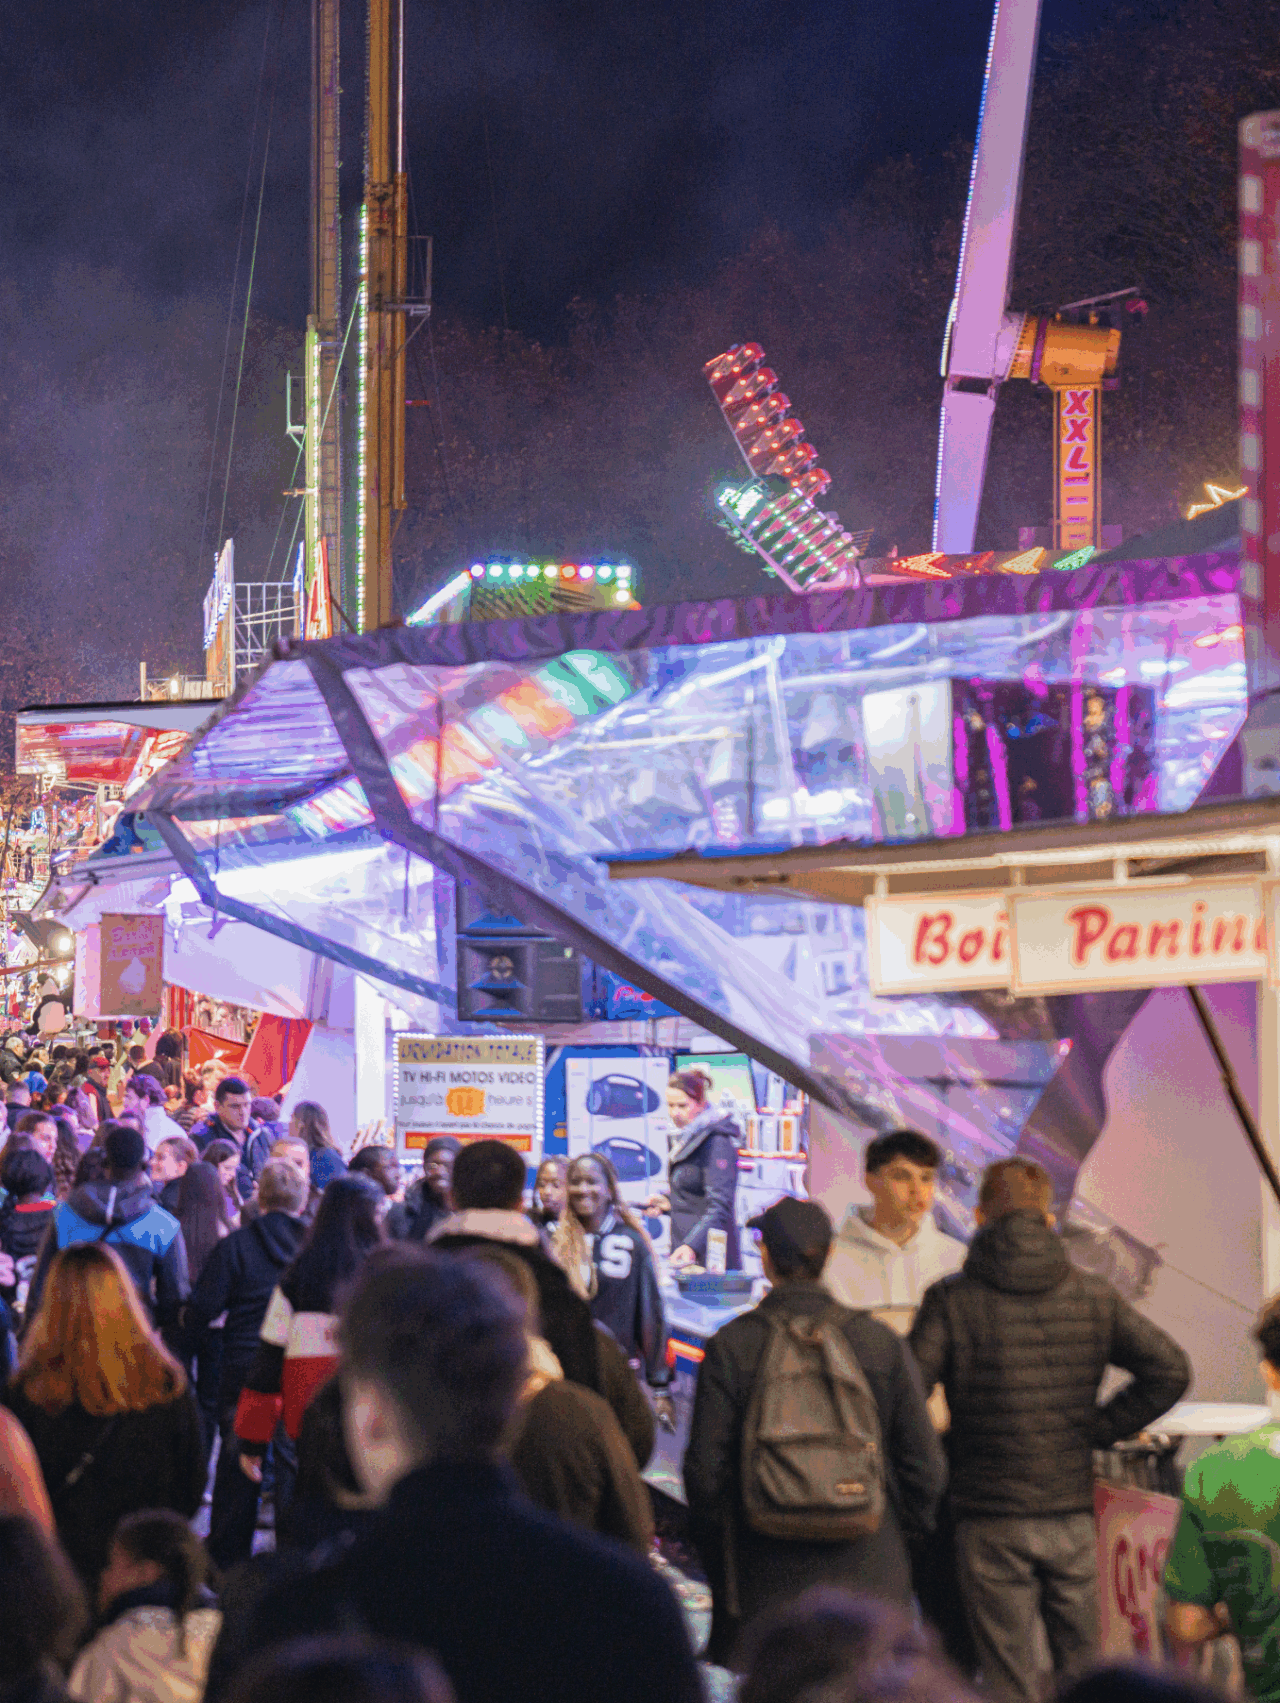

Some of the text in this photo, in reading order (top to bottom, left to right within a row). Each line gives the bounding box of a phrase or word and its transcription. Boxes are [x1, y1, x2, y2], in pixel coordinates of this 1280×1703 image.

[1062, 390, 1092, 473] XXL
[402, 1071, 536, 1084] TV HI-FI MOTOS VIDEO
